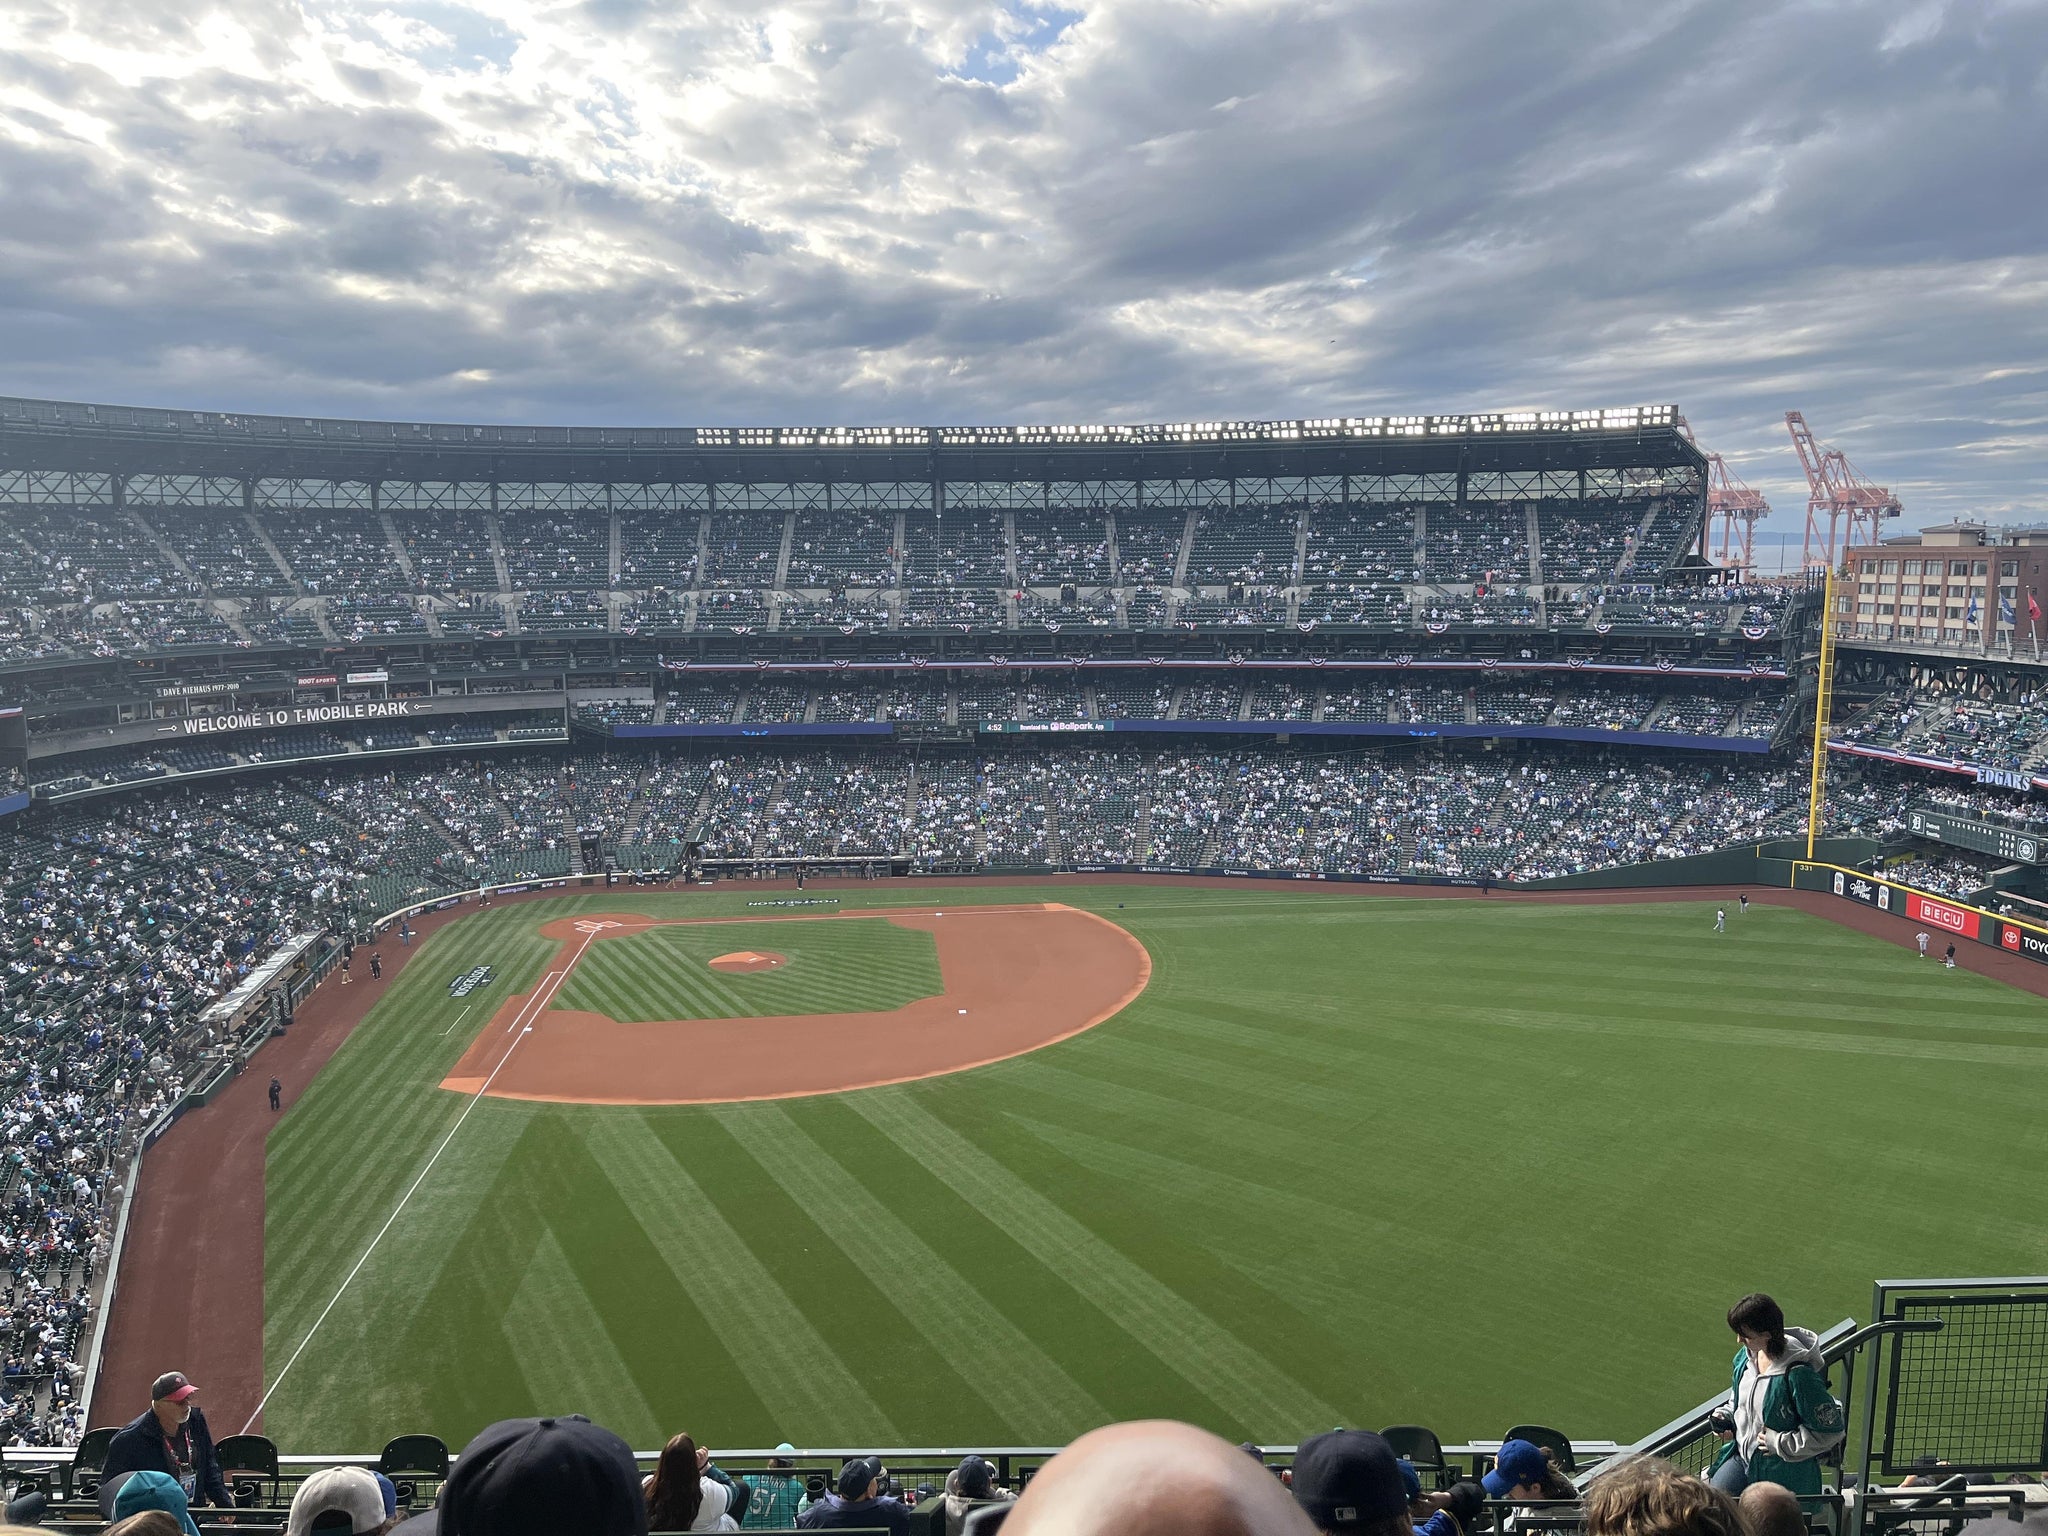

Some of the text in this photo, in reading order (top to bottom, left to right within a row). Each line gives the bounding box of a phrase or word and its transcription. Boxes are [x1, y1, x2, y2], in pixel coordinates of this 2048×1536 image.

[163, 683, 240, 697] DAVE NIEHAUS 1977-2010
[183, 701, 409, 734] WELCOME TO T-MOBILE PARK
[986, 723, 1003, 731] 4:52
[1799, 864, 1813, 872] 331
[1924, 905, 1961, 926] BECU
[749, 1486, 777, 1517] 51
